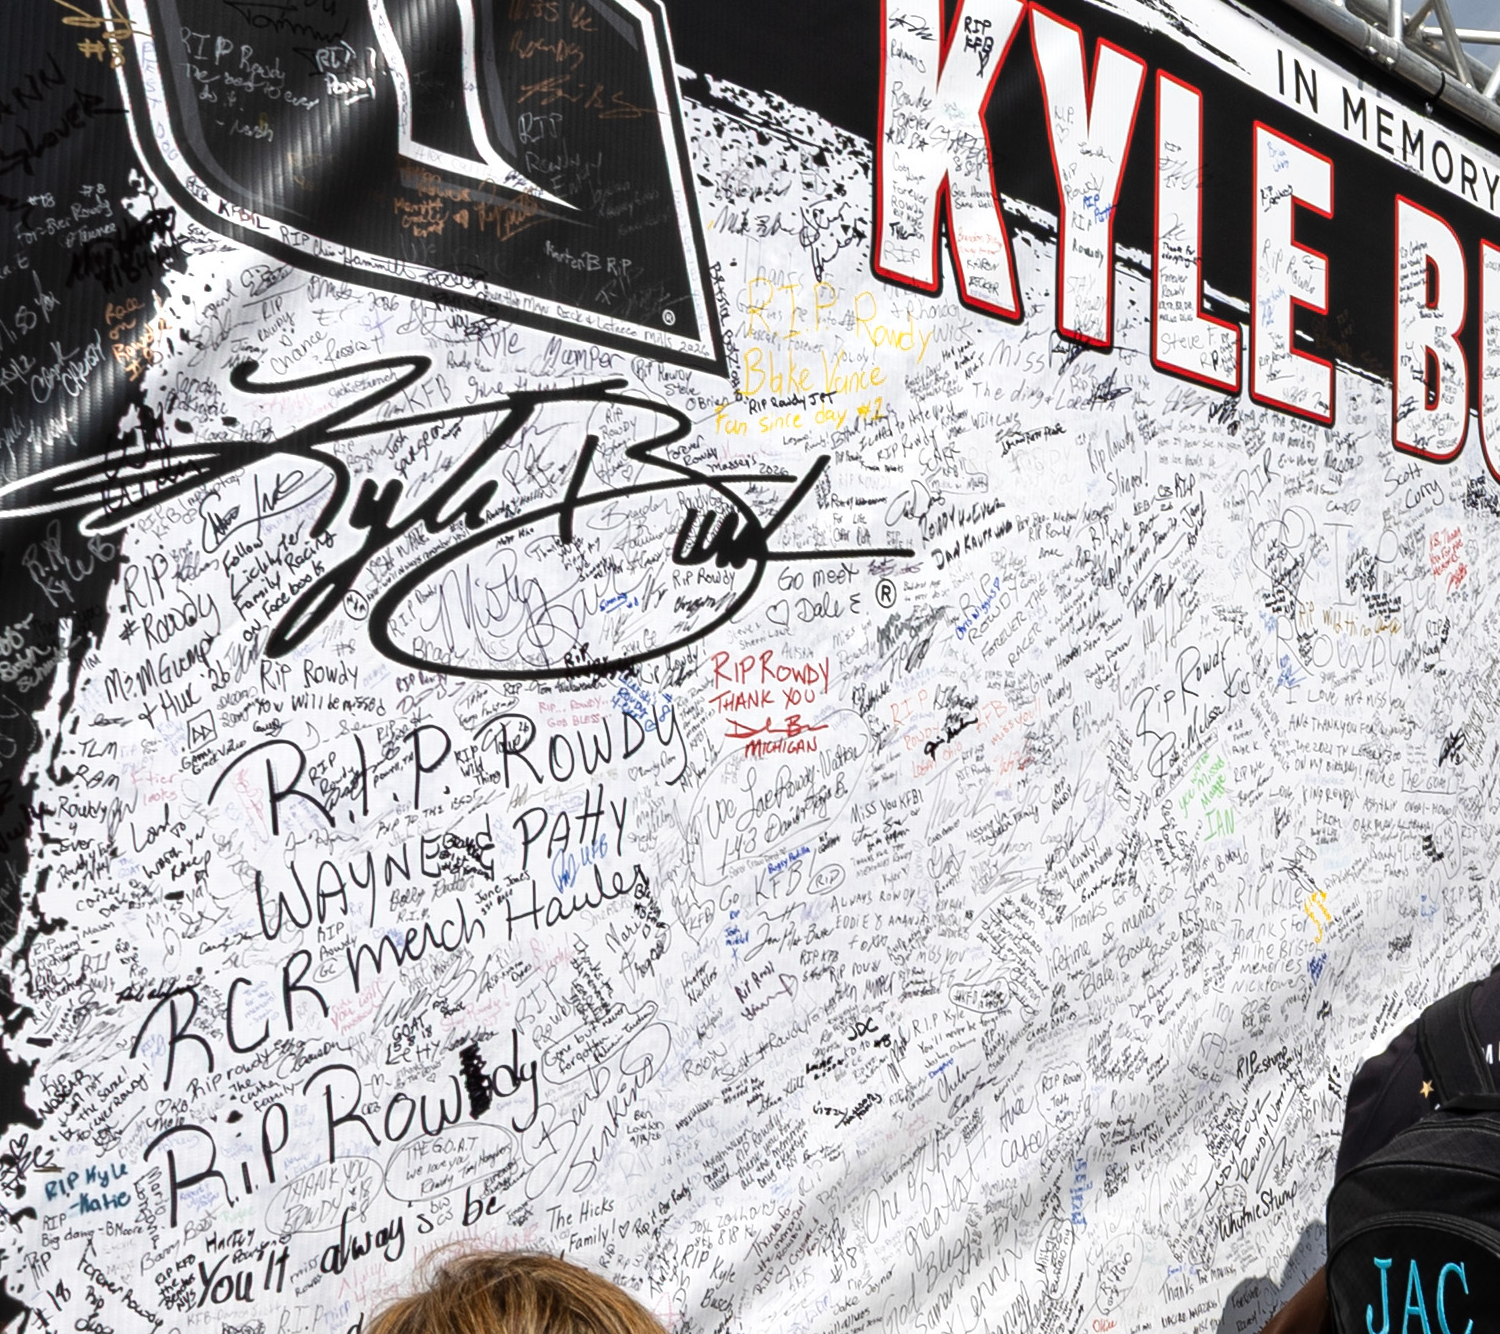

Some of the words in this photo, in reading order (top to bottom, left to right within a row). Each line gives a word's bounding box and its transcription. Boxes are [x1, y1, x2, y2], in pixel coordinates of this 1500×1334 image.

[1276, 48, 1320, 111] IN
[1343, 85, 1500, 211] MEMORY
[742, 348, 816, 398] Blake
[303, 658, 360, 693] Rowdy
[710, 651, 758, 690] RIP
[759, 650, 831, 694] ROWDY
[709, 691, 775, 714] THANK
[783, 687, 816, 706] YOU
[744, 738, 818, 758] MICHIGAN
[1204, 808, 1235, 842] IAN
